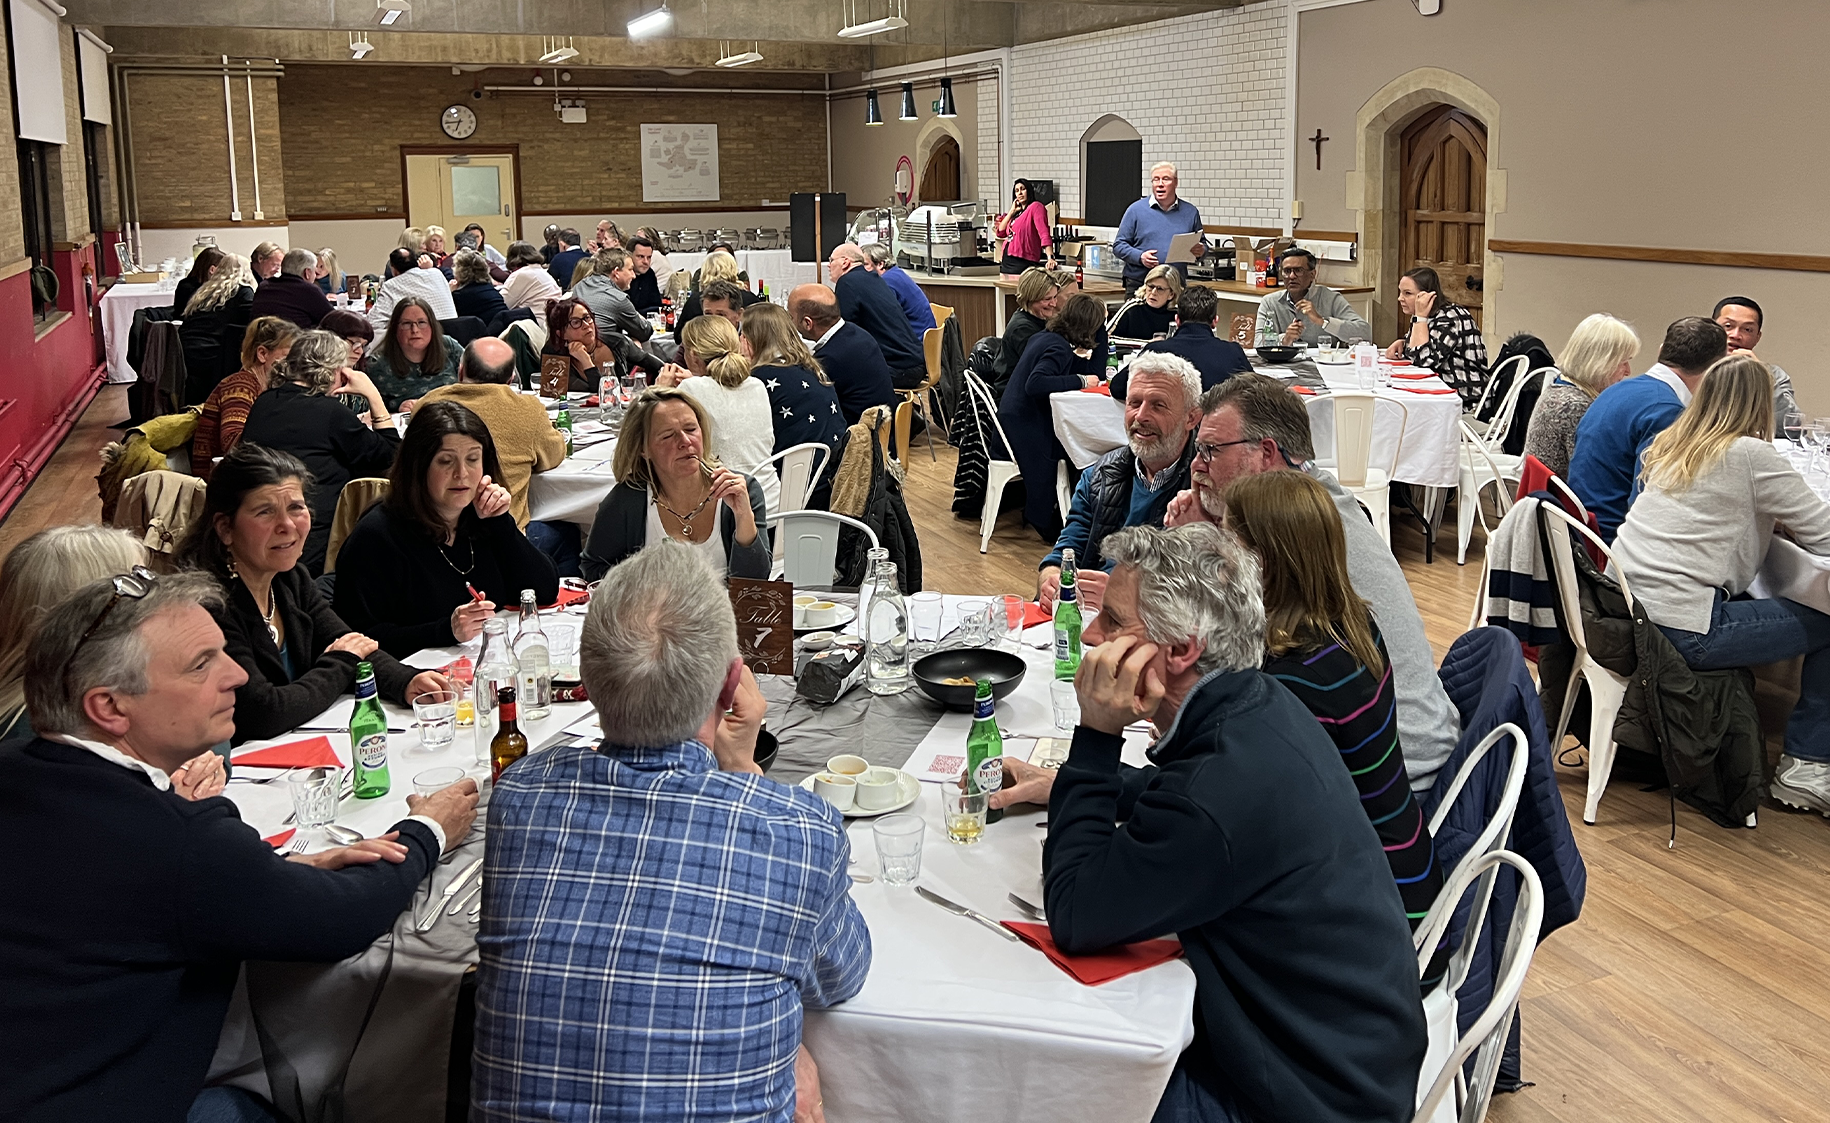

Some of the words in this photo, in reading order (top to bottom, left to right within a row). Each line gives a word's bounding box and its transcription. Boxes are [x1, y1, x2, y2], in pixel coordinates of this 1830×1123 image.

[1238, 330, 1247, 340] 5
[549, 376, 559, 387] 4
[739, 605, 782, 625] Table
[753, 627, 773, 649] 7
[359, 744, 386, 755] PERON
[979, 768, 1002, 778] PERO
